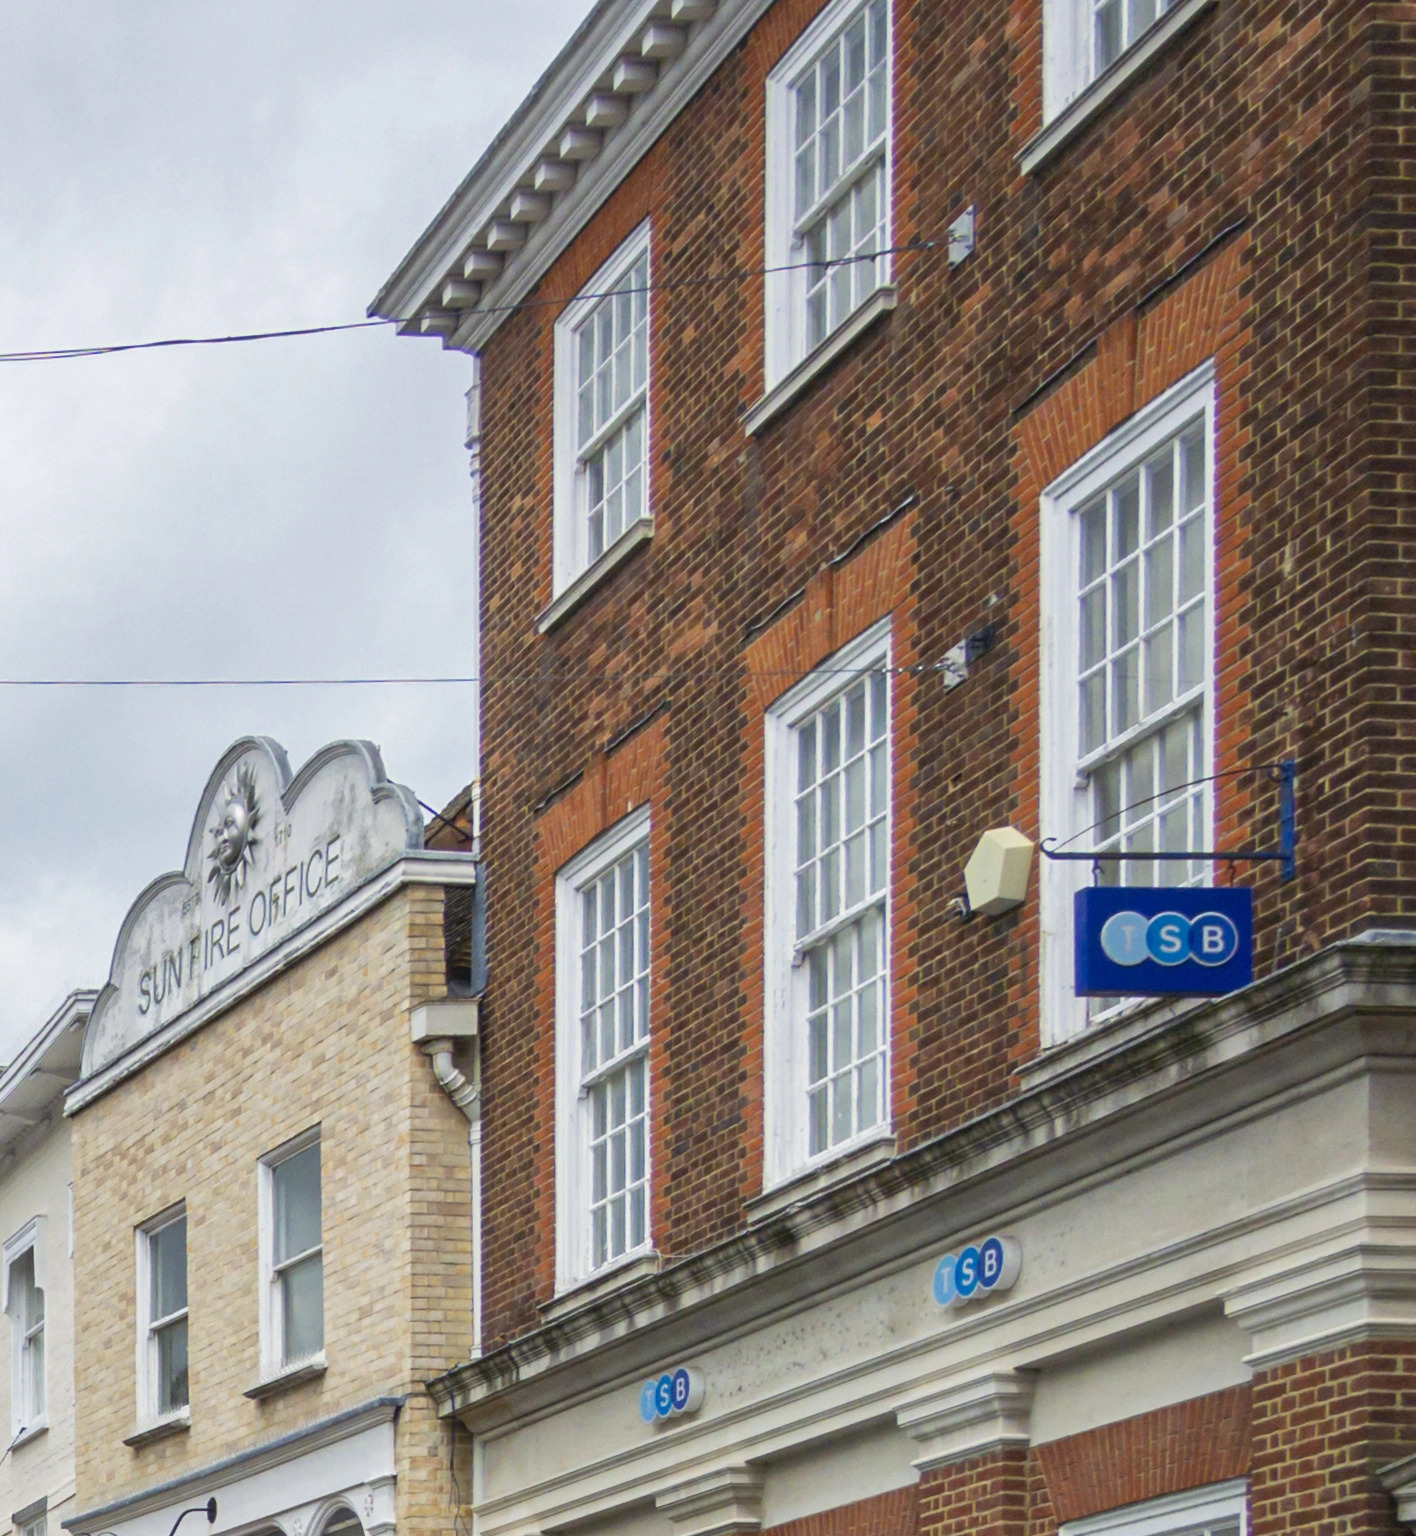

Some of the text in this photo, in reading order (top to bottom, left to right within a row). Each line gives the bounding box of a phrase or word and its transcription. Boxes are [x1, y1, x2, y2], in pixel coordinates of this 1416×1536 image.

[138, 833, 341, 1015] SUN FIRE OFFICE
